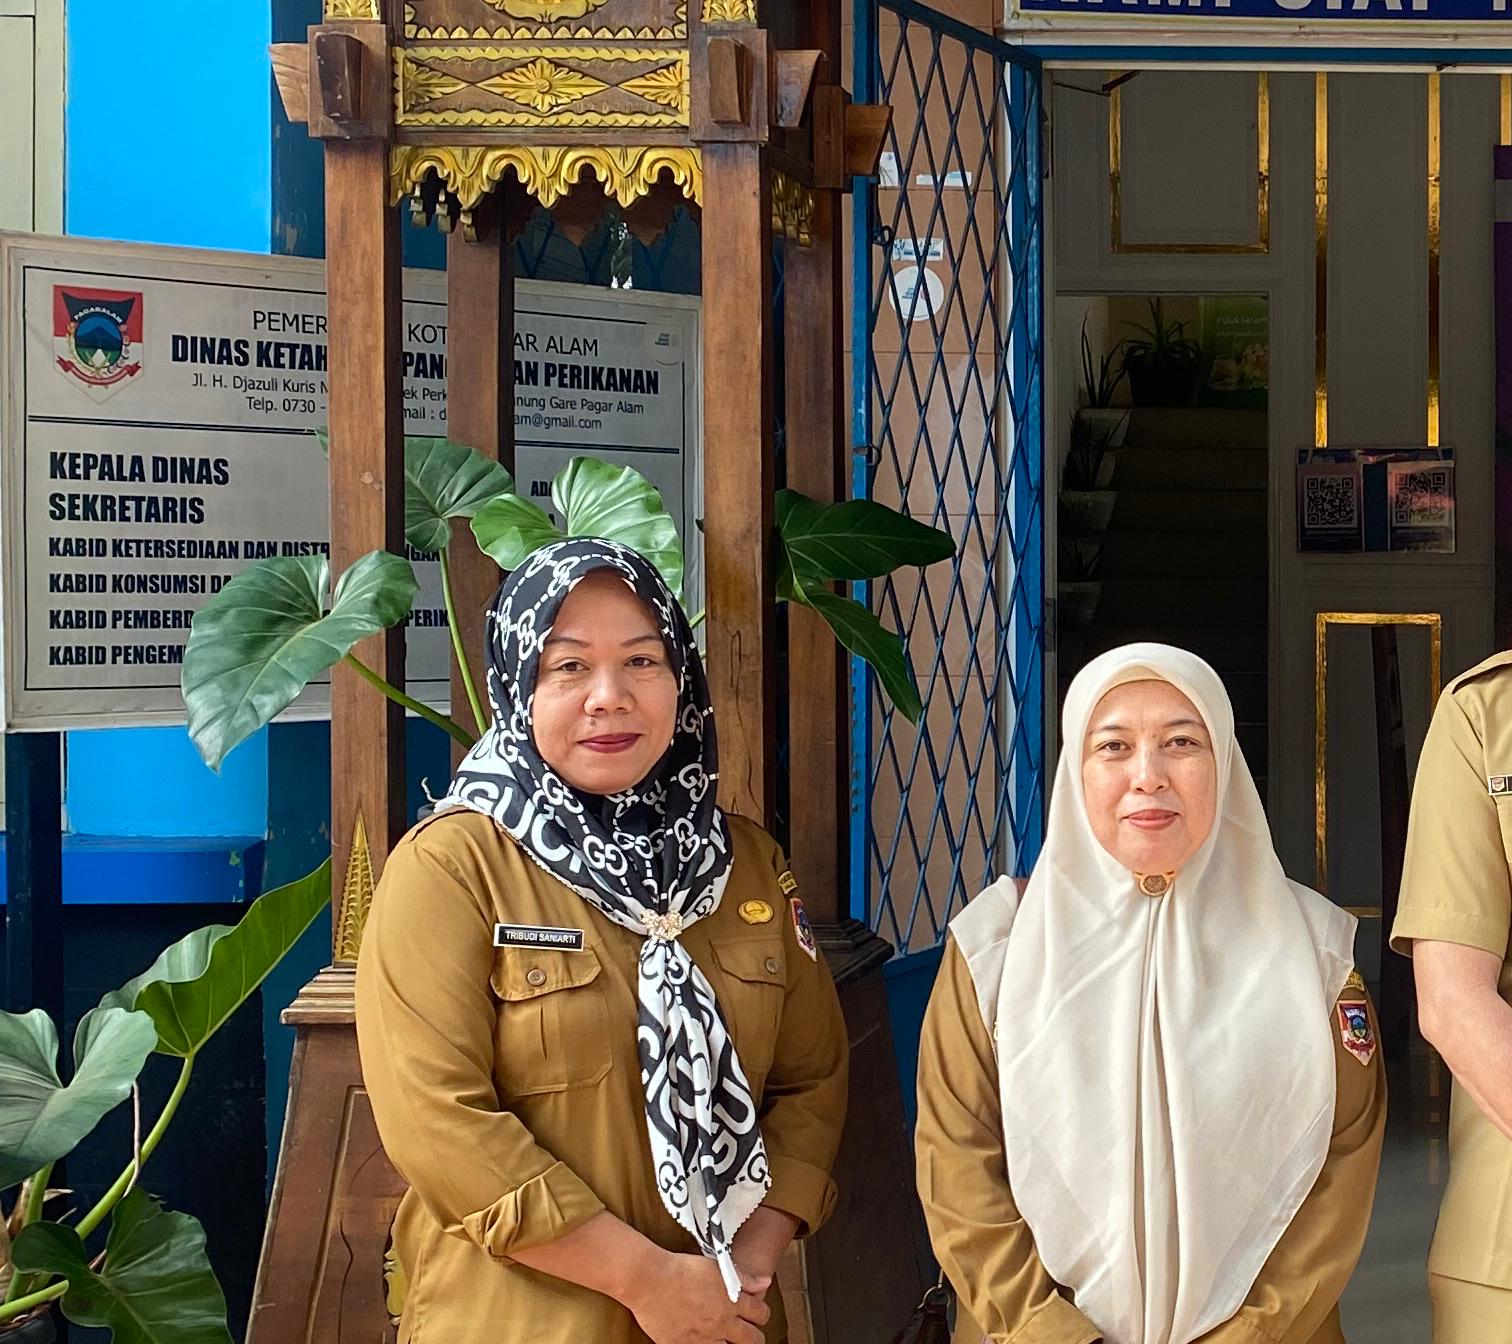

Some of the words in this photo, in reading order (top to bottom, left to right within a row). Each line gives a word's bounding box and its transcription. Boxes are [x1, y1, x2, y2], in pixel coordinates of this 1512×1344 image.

[253, 310, 328, 335] PEMER
[407, 323, 448, 345] KOT
[545, 335, 598, 357] ALAM
[171, 334, 250, 367] DINAS
[256, 340, 328, 372] KETAH
[544, 362, 660, 395] PERIKANAN
[212, 374, 228, 389] H.
[232, 375, 278, 393] Djazuli
[282, 378, 317, 394] Kuris
[549, 396, 577, 410] Gare
[580, 398, 614, 415] Pagar
[616, 401, 645, 414] Alam
[245, 396, 278, 413] Telp.
[282, 398, 316, 414] 0730
[49, 451, 147, 483] KEPALA
[151, 455, 230, 486] DINAS
[48, 492, 206, 525] SEKRETARIS
[48, 537, 107, 558] KABID
[111, 538, 239, 560] KETERSEDIAAN
[243, 541, 278, 560] DAN
[48, 573, 107, 594] KABID
[111, 574, 206, 594] KONSUMSI
[210, 574, 234, 594] DA
[48, 609, 107, 630] KABID
[111, 609, 194, 630] PEMBERD
[48, 646, 107, 666] KABID
[111, 645, 187, 666] PENGEM
